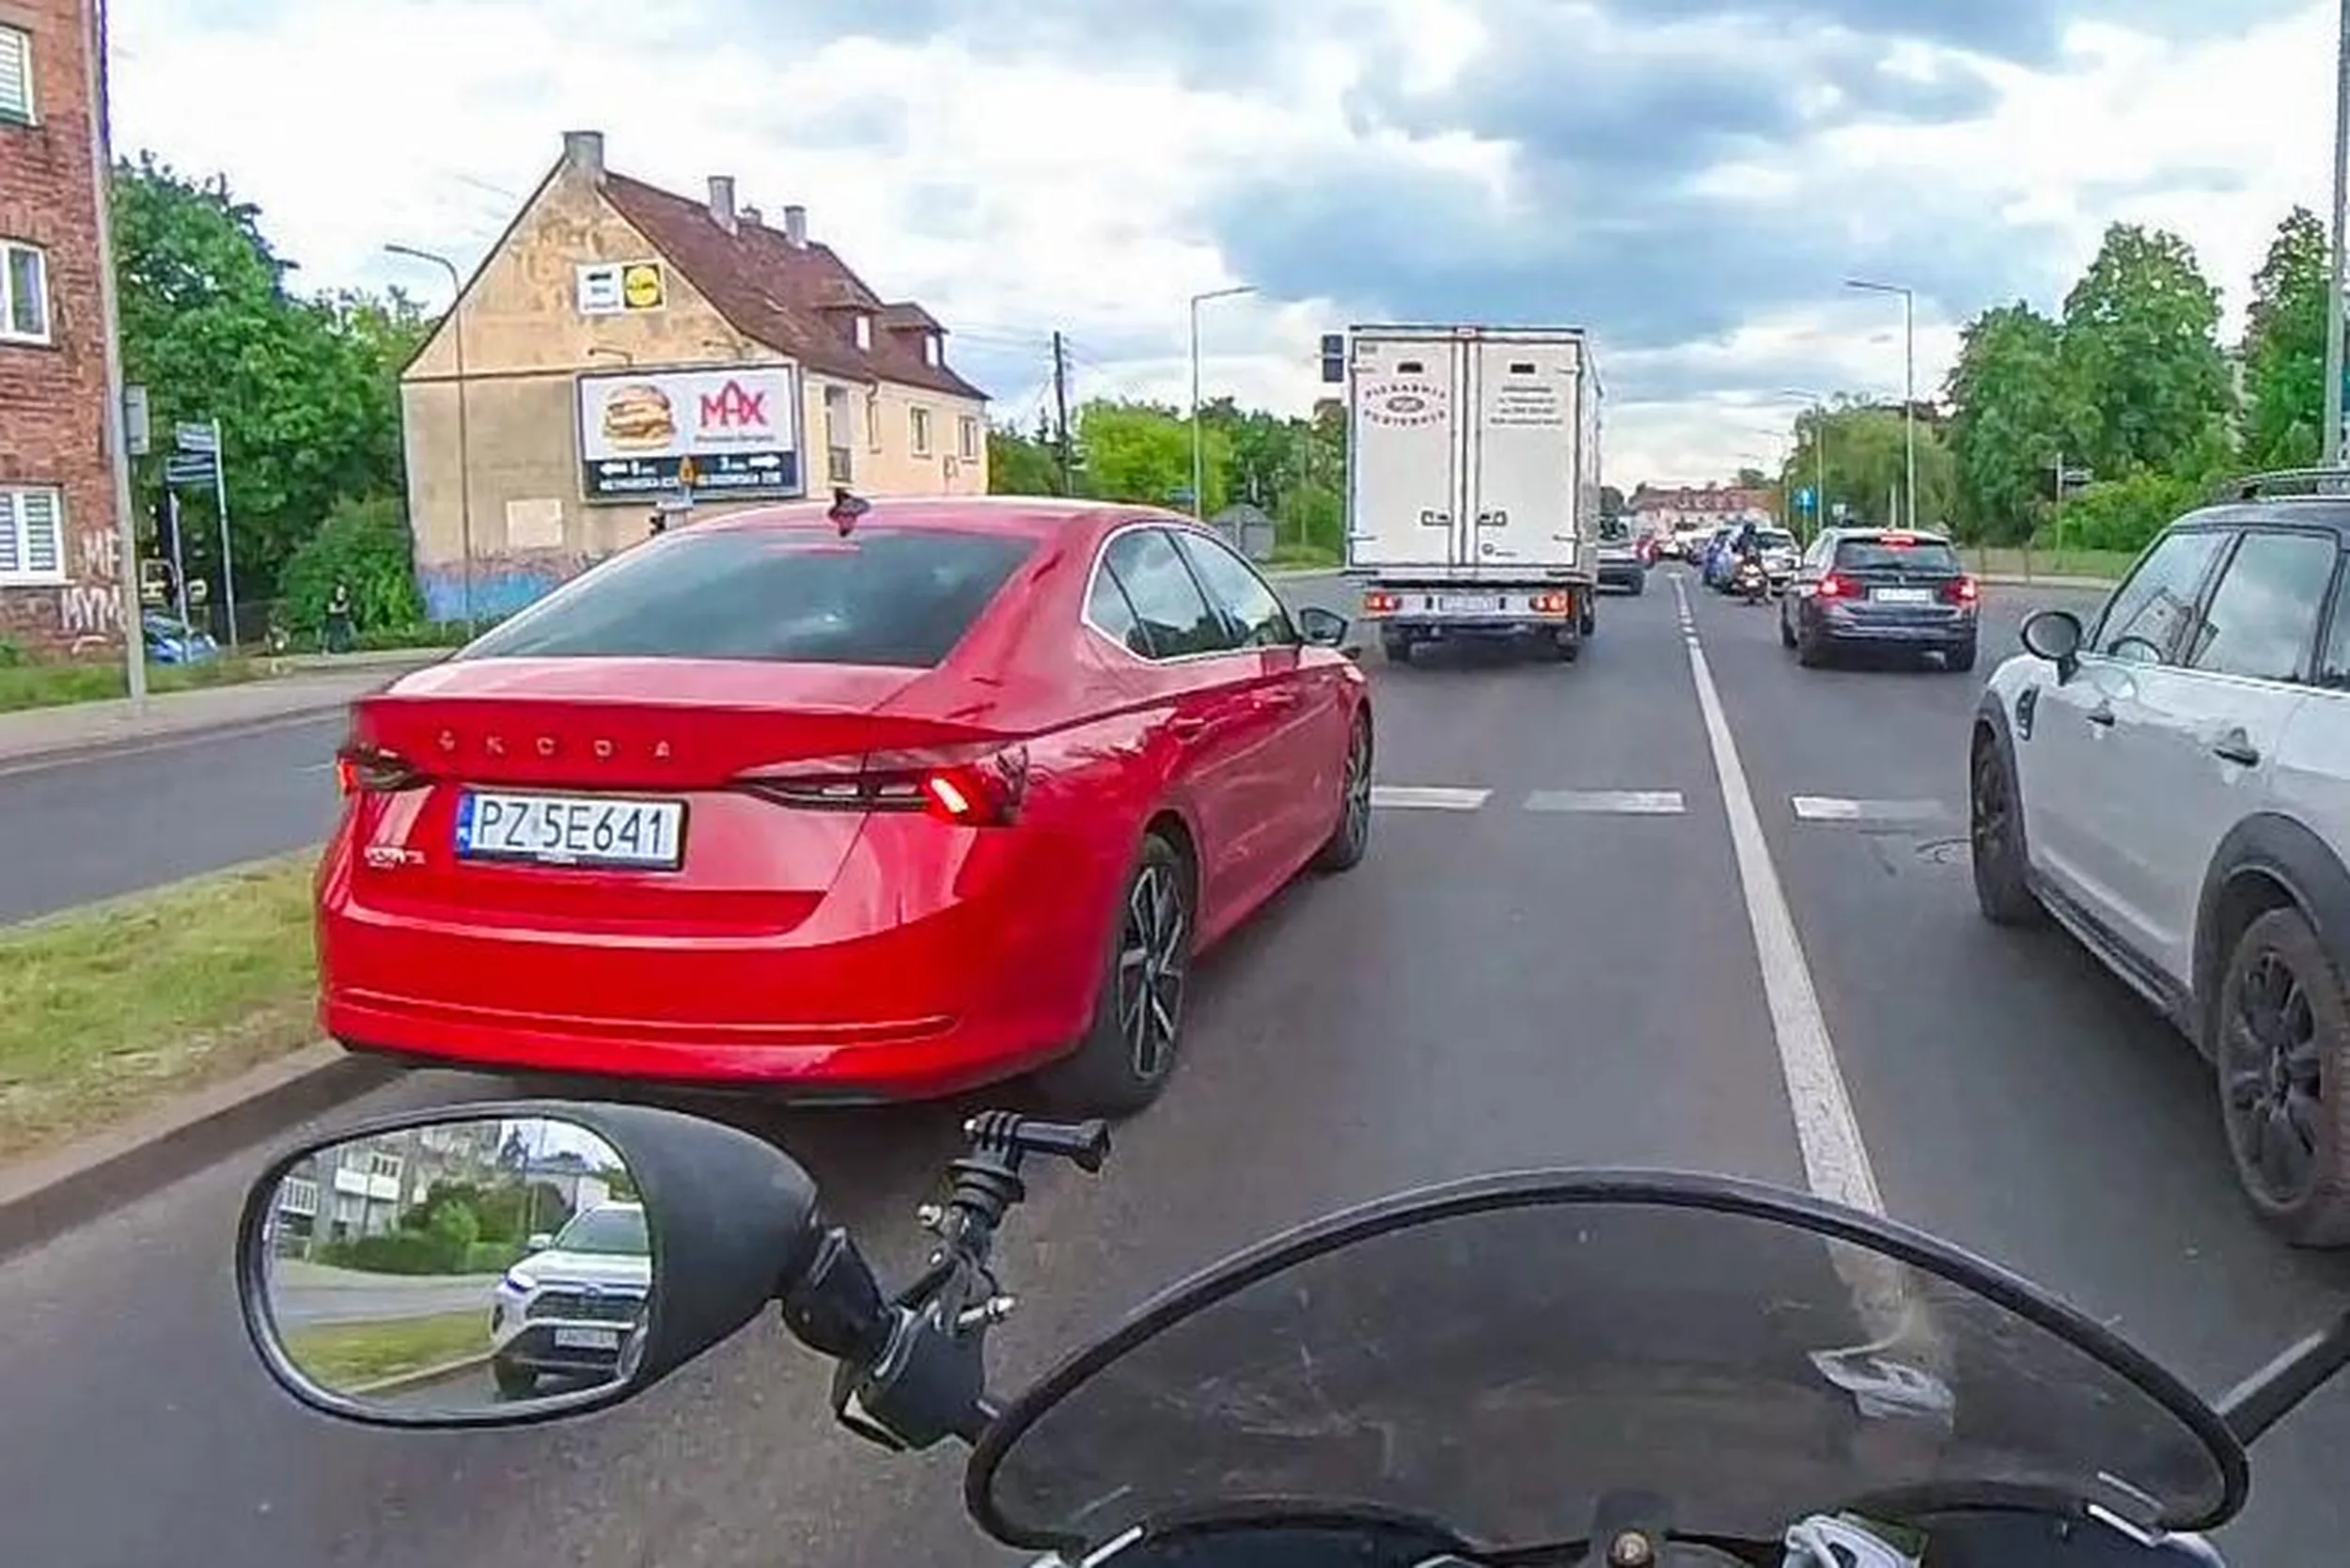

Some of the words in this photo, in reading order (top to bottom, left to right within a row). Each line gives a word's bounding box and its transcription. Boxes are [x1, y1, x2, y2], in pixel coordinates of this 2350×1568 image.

[699, 380, 768, 427] MAX
[478, 800, 530, 847] PZ
[541, 803, 663, 854] 5E641
